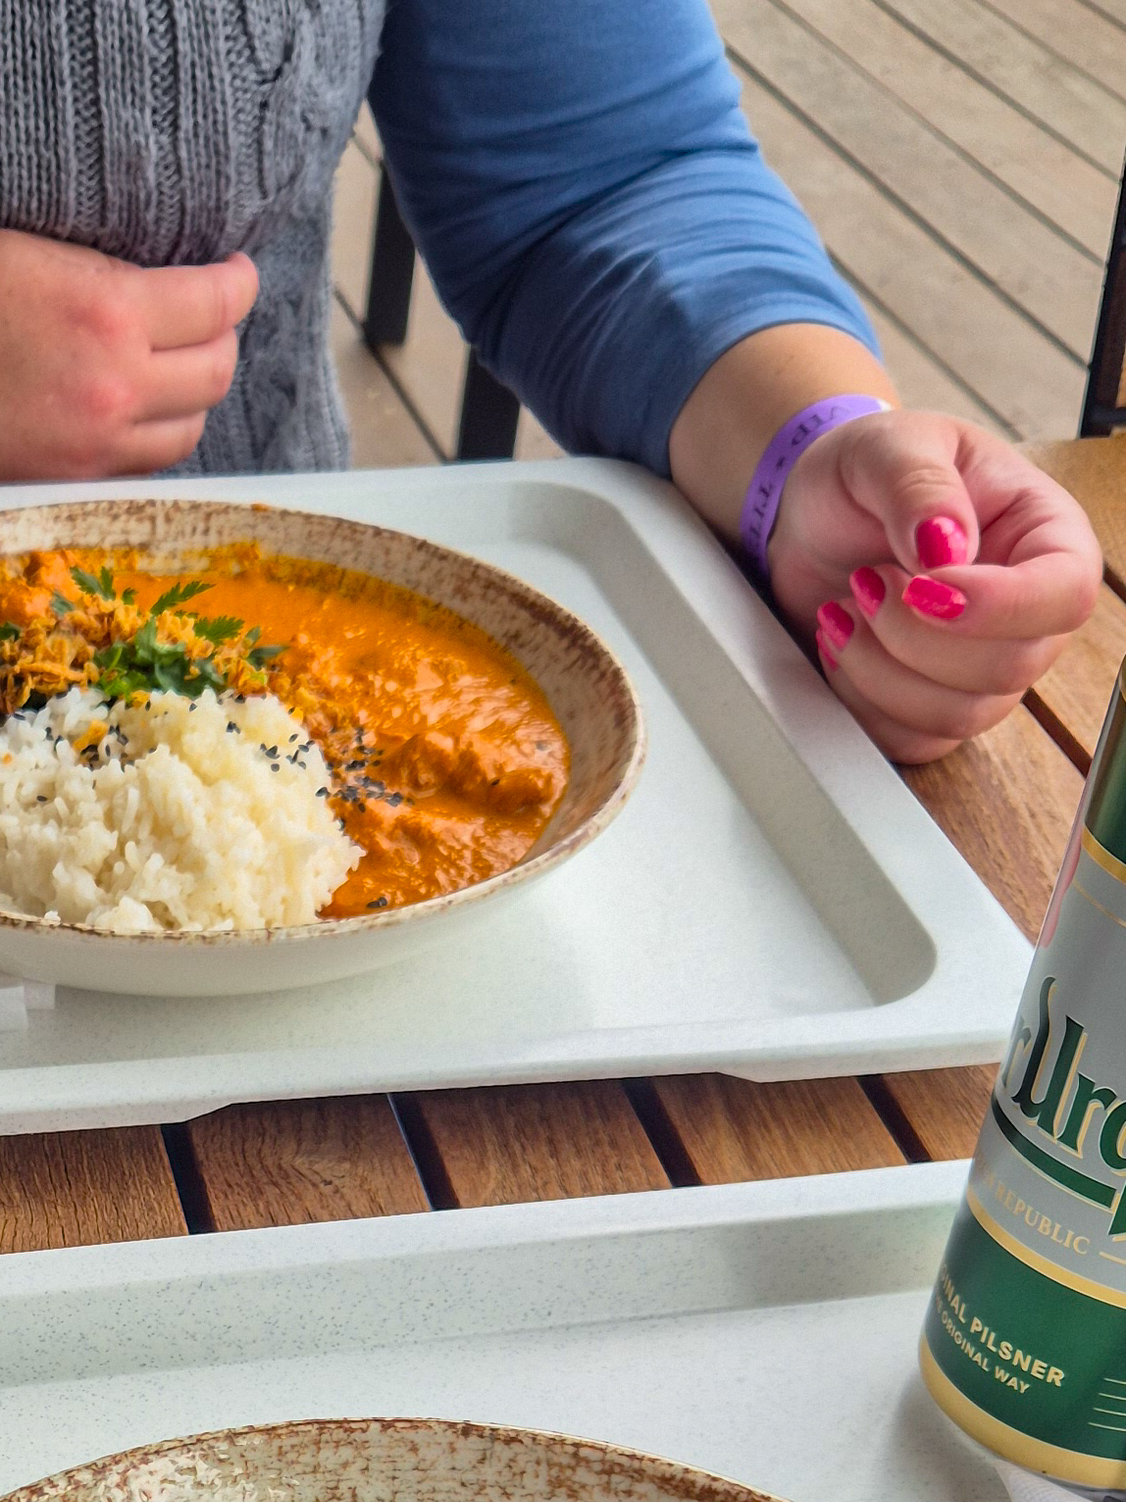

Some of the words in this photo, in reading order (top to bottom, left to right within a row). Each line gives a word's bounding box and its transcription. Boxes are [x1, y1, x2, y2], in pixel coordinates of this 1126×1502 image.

[941, 1310, 990, 1372] ORIGINAL
[994, 1365, 1031, 1394] WAY
[969, 1316, 1065, 1387] PILSNER
